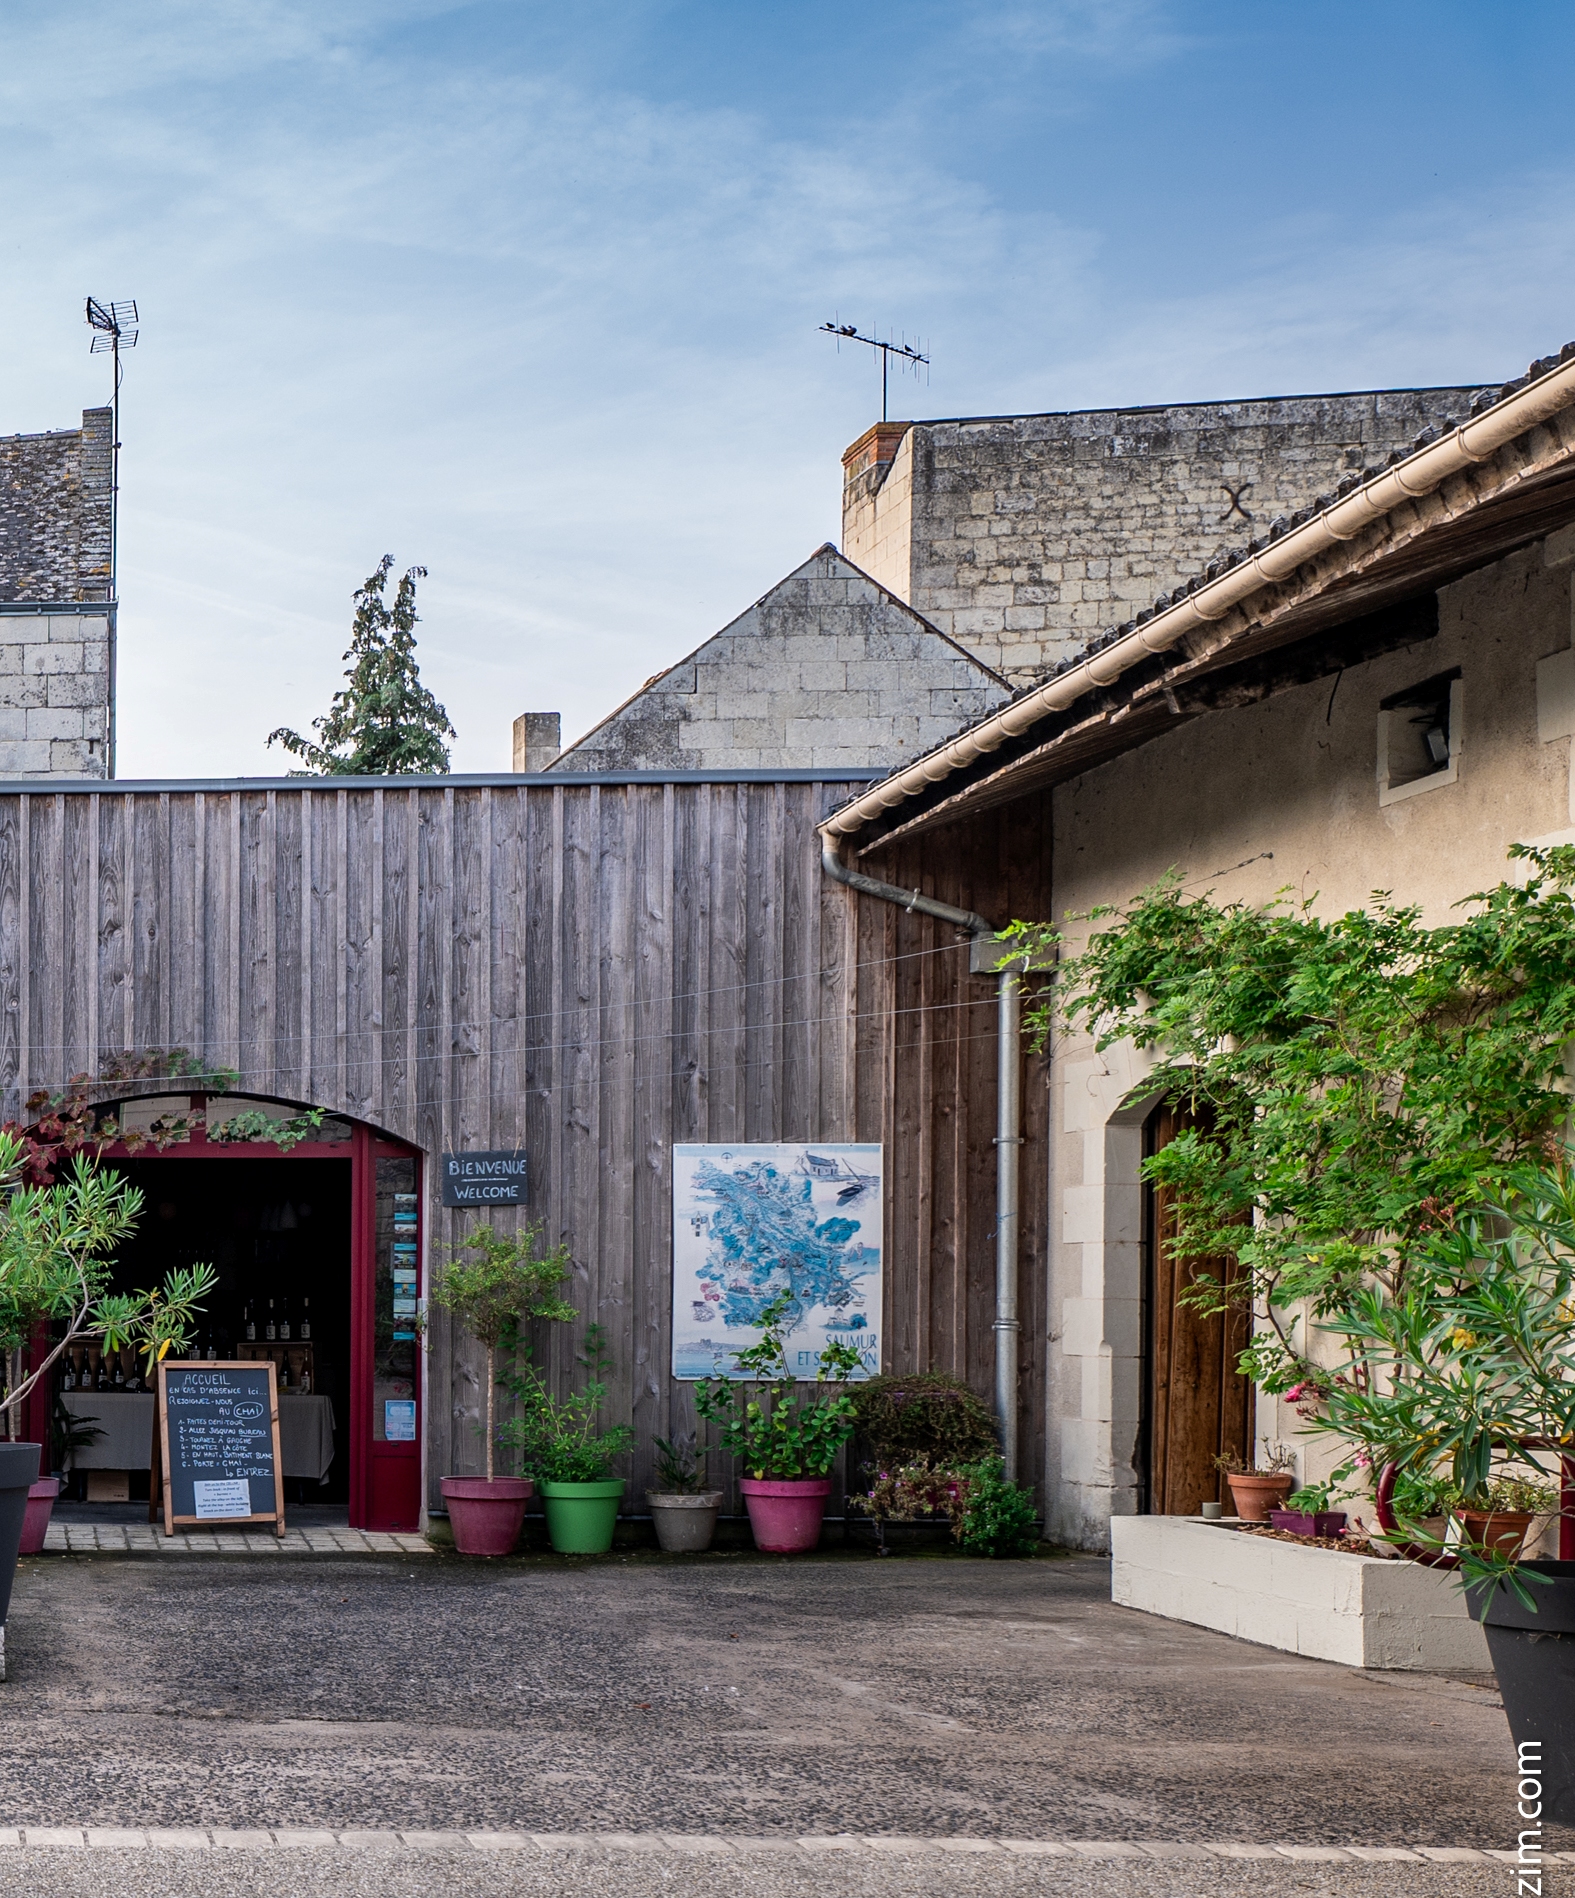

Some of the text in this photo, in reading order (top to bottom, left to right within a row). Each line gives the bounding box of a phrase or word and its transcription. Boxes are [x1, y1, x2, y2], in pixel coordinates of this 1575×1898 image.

[454, 1185, 519, 1199] WELCOME
[798, 1351, 810, 1366] ET
[219, 1407, 230, 1415] AU
[236, 1467, 273, 1477] ENTREZ
